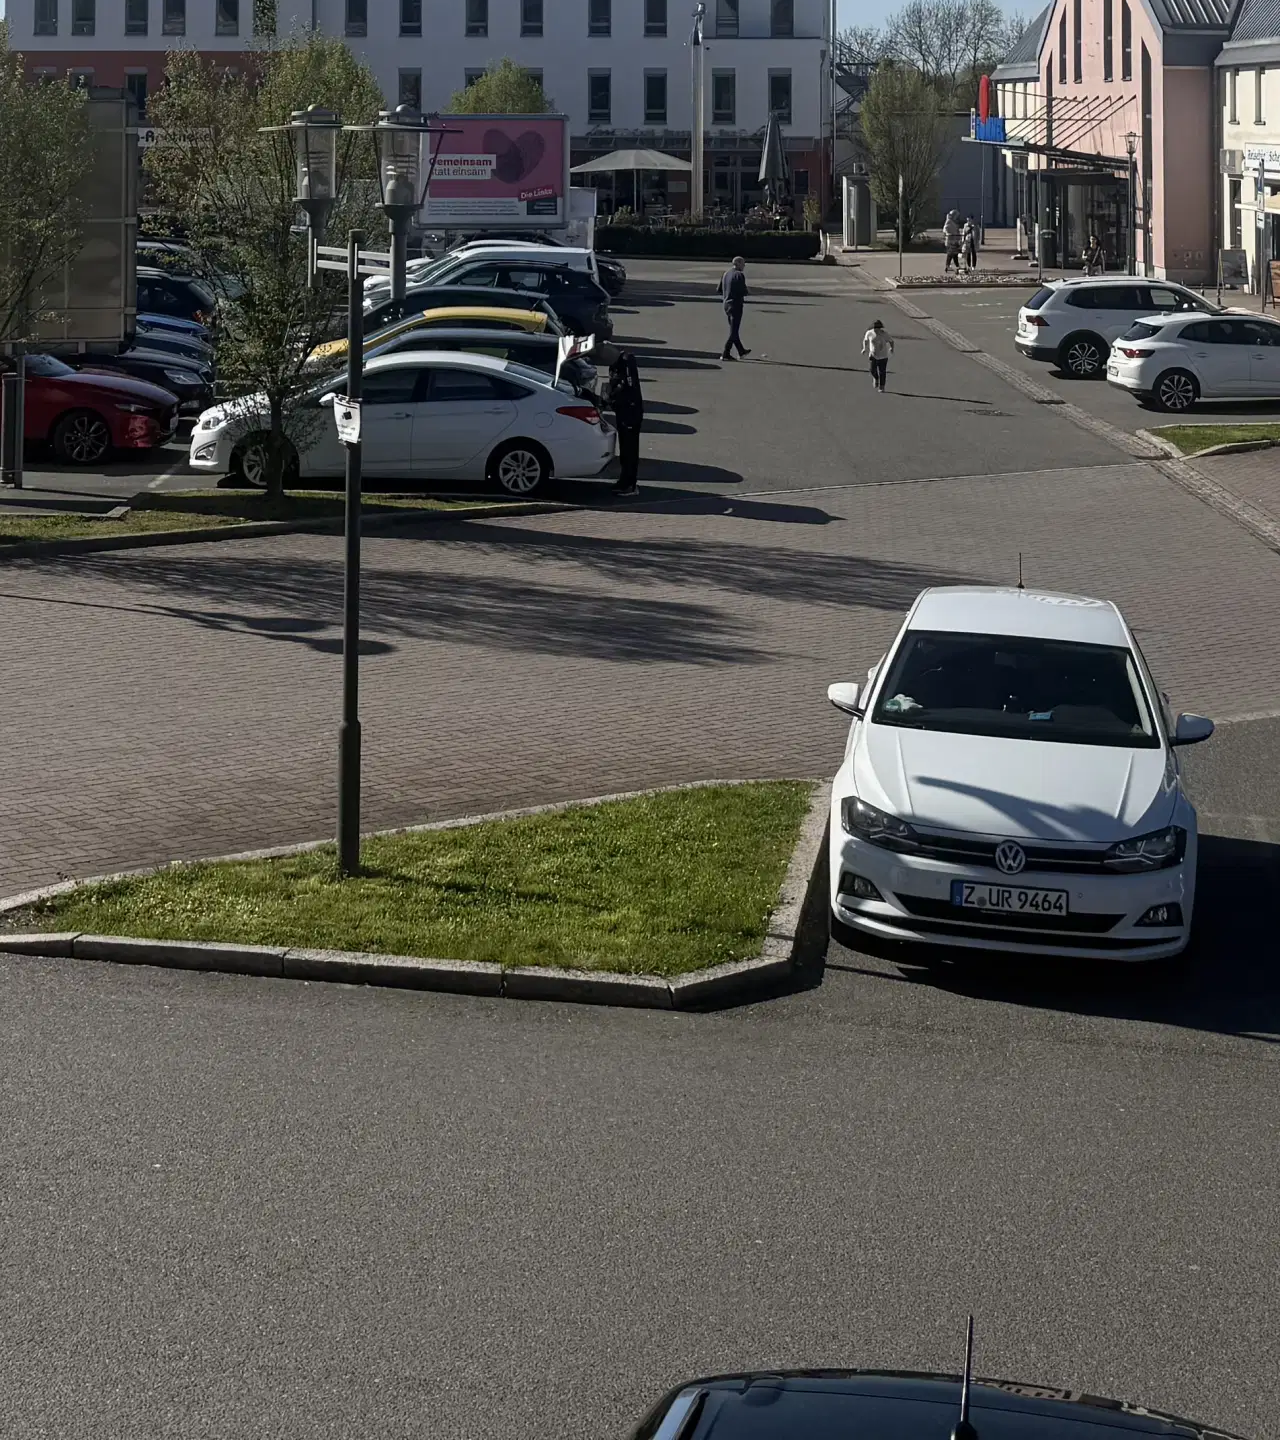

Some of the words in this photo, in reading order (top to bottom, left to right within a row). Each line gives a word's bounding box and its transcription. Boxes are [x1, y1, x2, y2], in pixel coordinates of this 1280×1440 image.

[428, 157, 492, 166] Gemeinsam
[452, 167, 487, 176] einsam
[520, 191, 533, 200] Die
[964, 885, 976, 905] Z
[988, 887, 1012, 908] UR
[1017, 890, 1064, 913] 9464
